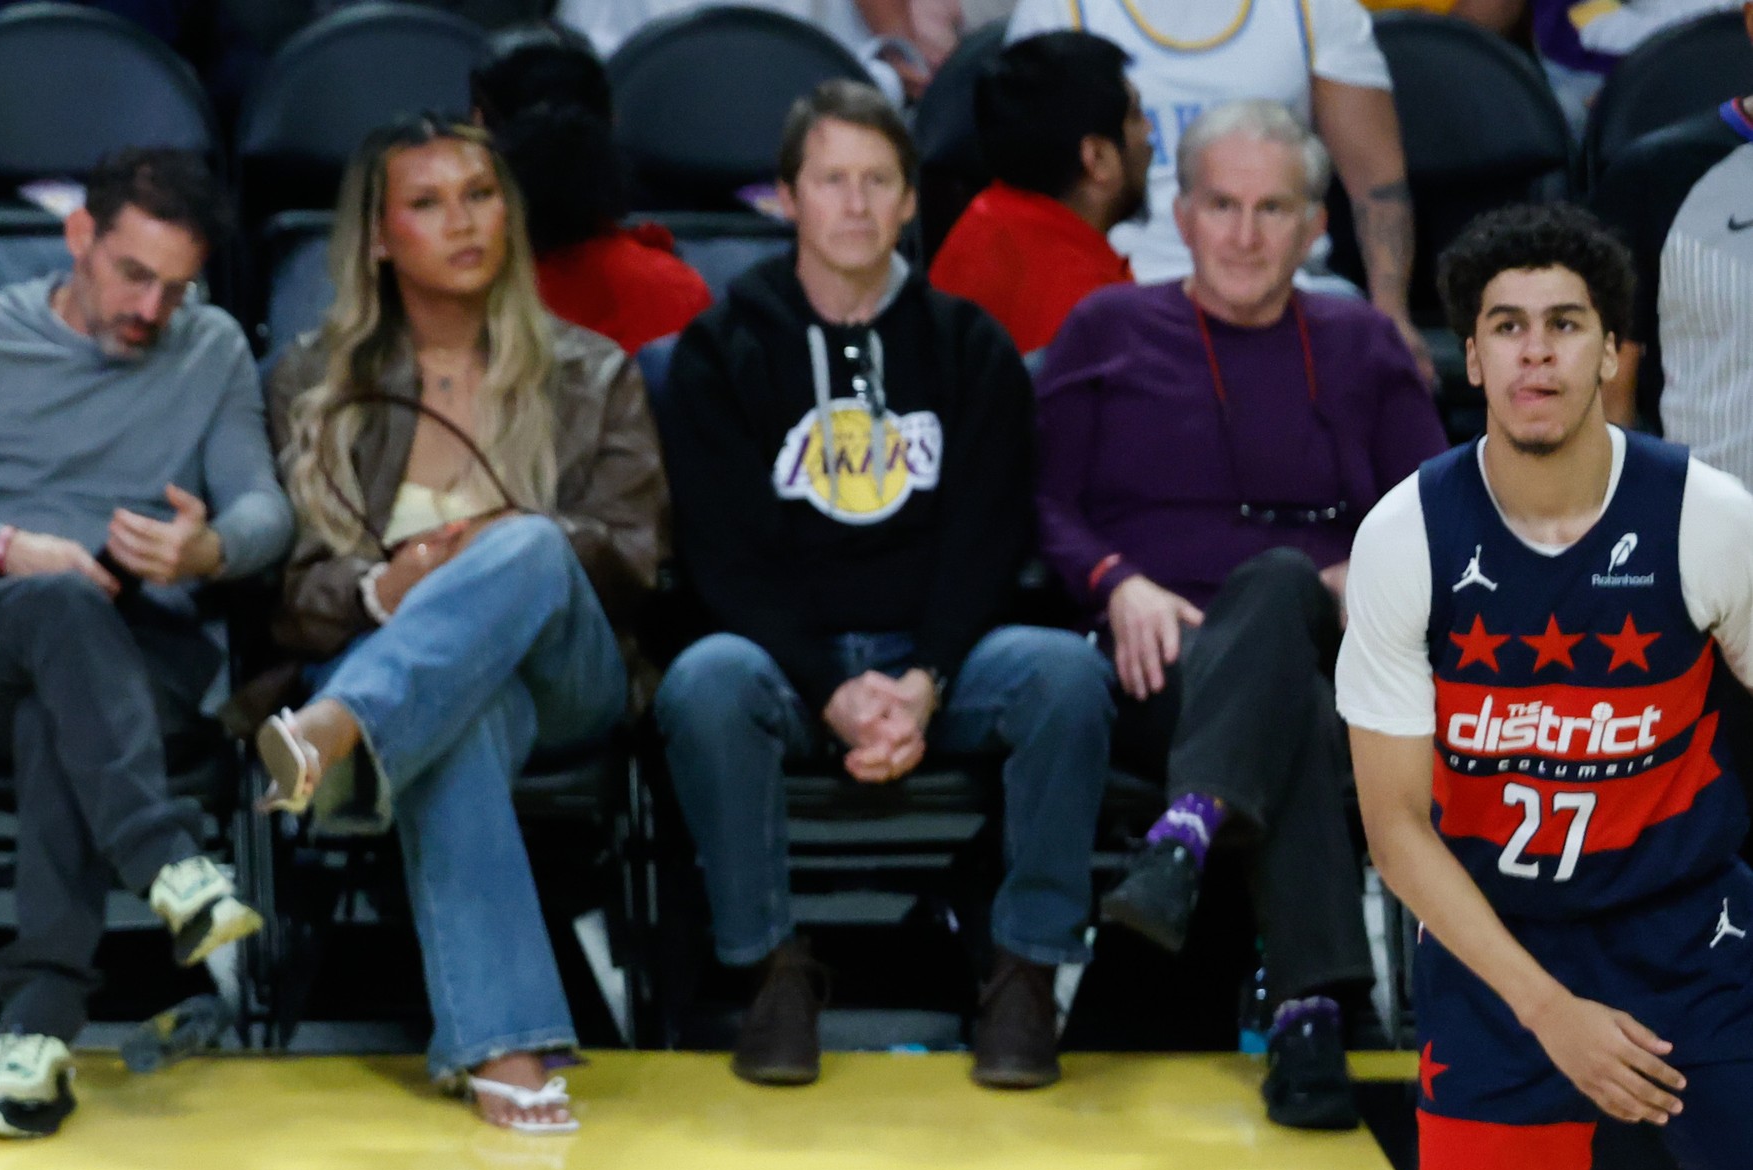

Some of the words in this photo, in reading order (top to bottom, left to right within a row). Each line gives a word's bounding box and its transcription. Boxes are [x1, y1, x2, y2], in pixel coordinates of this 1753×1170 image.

[1591, 572, 1655, 587] Robinhood
[1448, 693, 1662, 754] district
[1507, 701, 1543, 718] THE
[1497, 781, 1598, 883] 27
